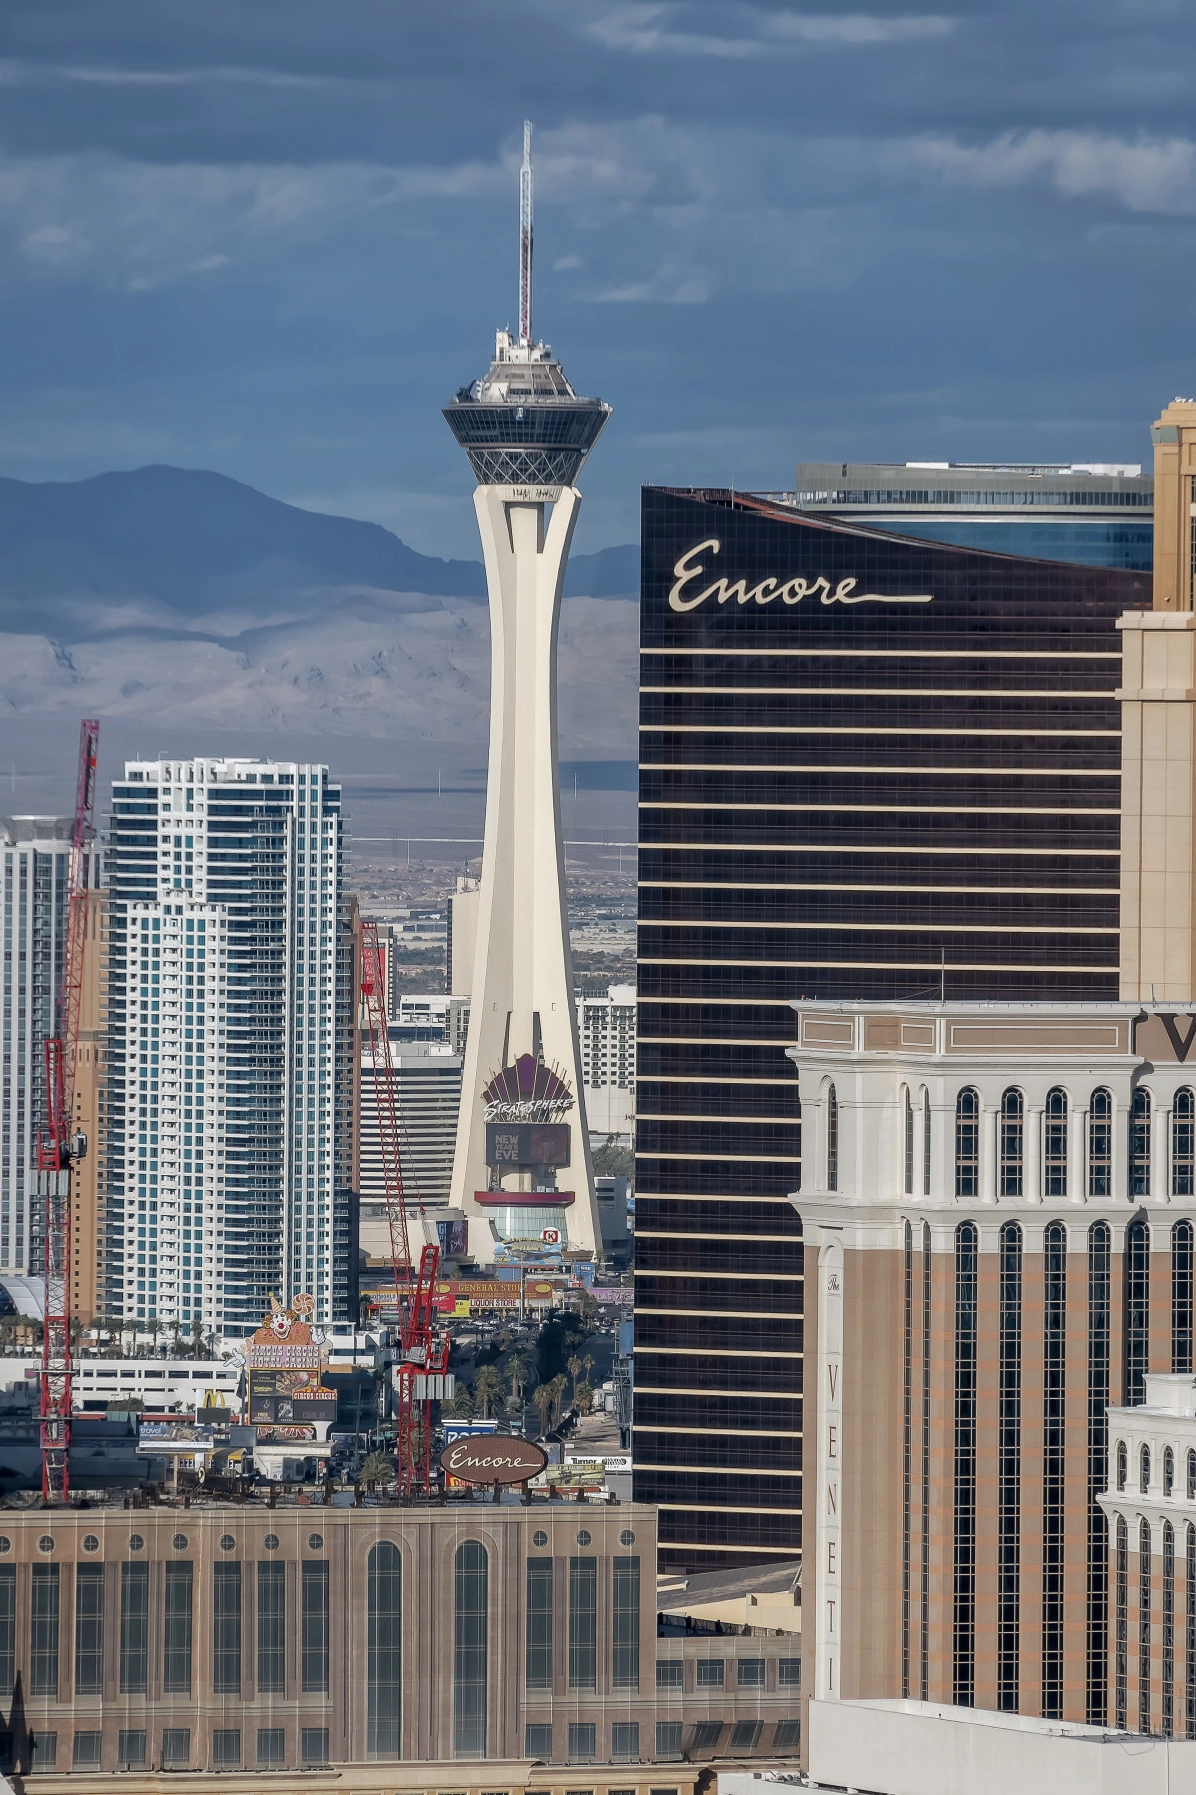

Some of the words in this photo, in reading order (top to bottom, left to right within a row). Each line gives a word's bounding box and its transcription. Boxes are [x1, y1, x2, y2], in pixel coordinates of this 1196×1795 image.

[668, 538, 933, 612] Encore
[495, 1134, 518, 1144] NEW
[495, 1150, 518, 1160] EVE
[458, 1283, 499, 1292] GENERAL
[827, 1274, 839, 1290] The
[470, 1299, 494, 1307] LIQUOR
[495, 1299, 517, 1307] STORE
[250, 1345, 283, 1356] CIRCUS
[286, 1346, 319, 1357] CIRCUS
[251, 1356, 283, 1368] HOTEL
[285, 1357, 319, 1368] CASINO
[293, 1392, 314, 1400] CIRCUS
[315, 1392, 335, 1400] CIRCUS
[449, 1445, 541, 1469] Encore
